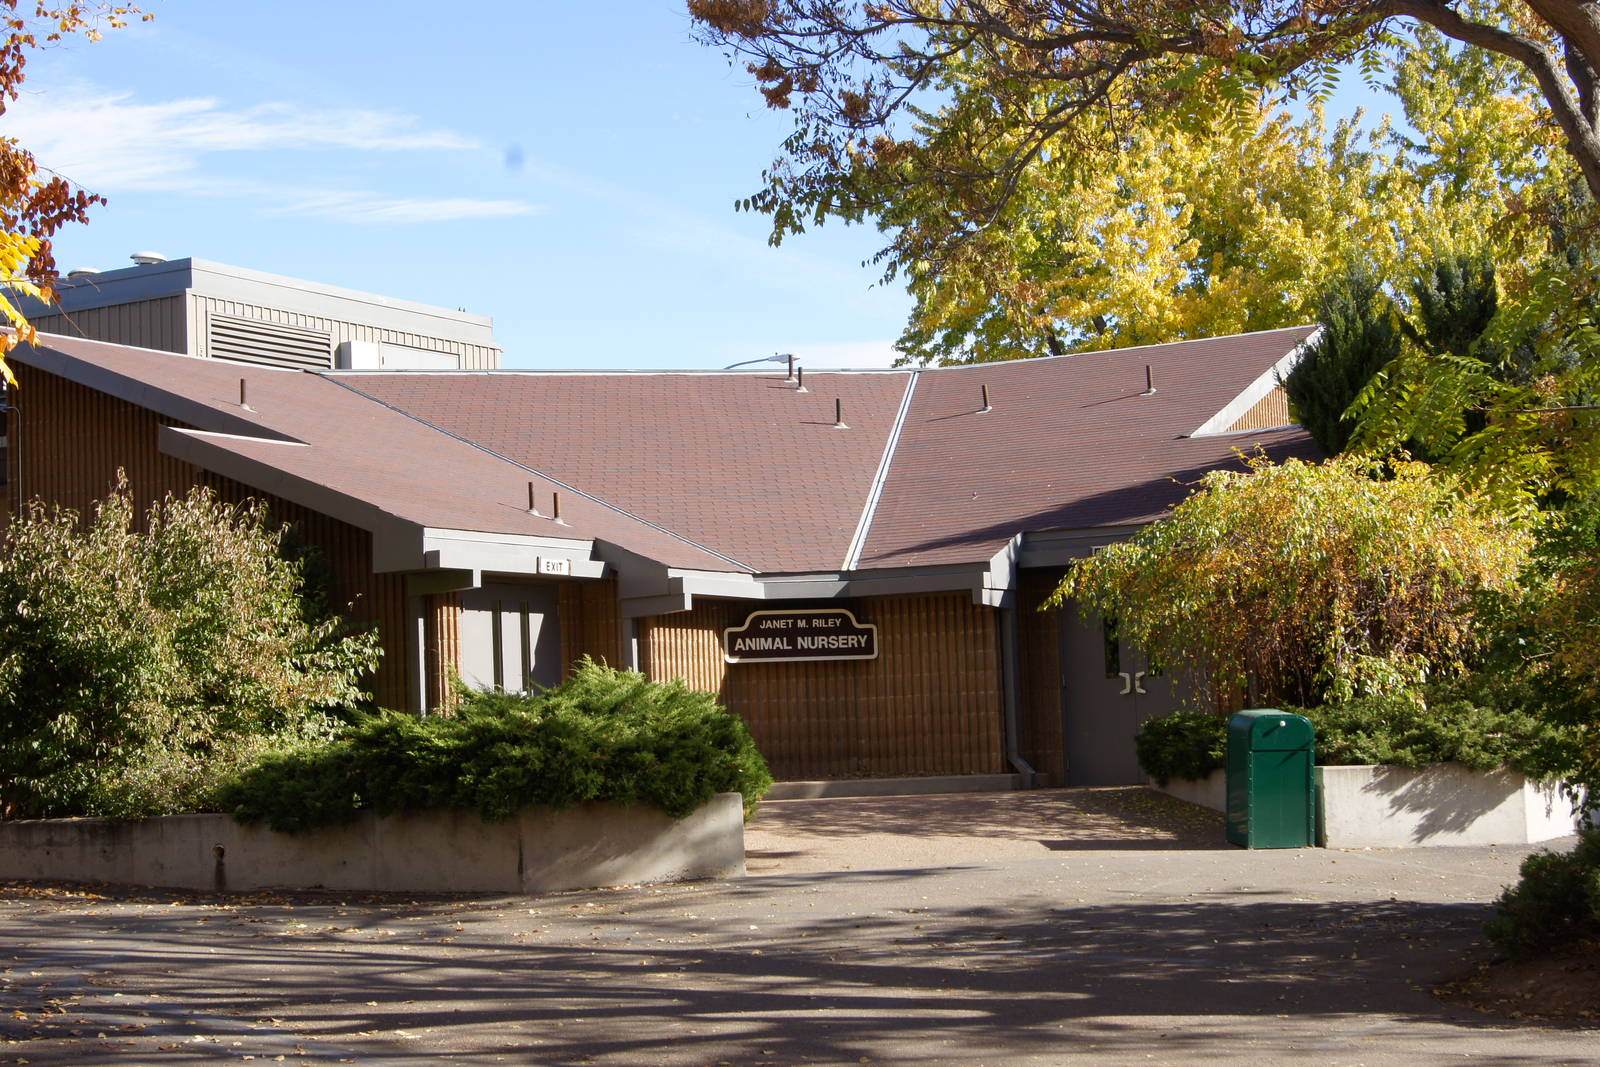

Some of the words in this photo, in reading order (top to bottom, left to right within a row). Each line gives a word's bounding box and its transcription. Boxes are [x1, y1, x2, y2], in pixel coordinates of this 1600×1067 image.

[546, 561, 563, 572] EXIT
[759, 619, 793, 629] JANET
[797, 620, 809, 628] M.
[812, 618, 842, 628] RILEY
[734, 637, 792, 651] ANIMAL
[797, 635, 867, 649] NURSERY
